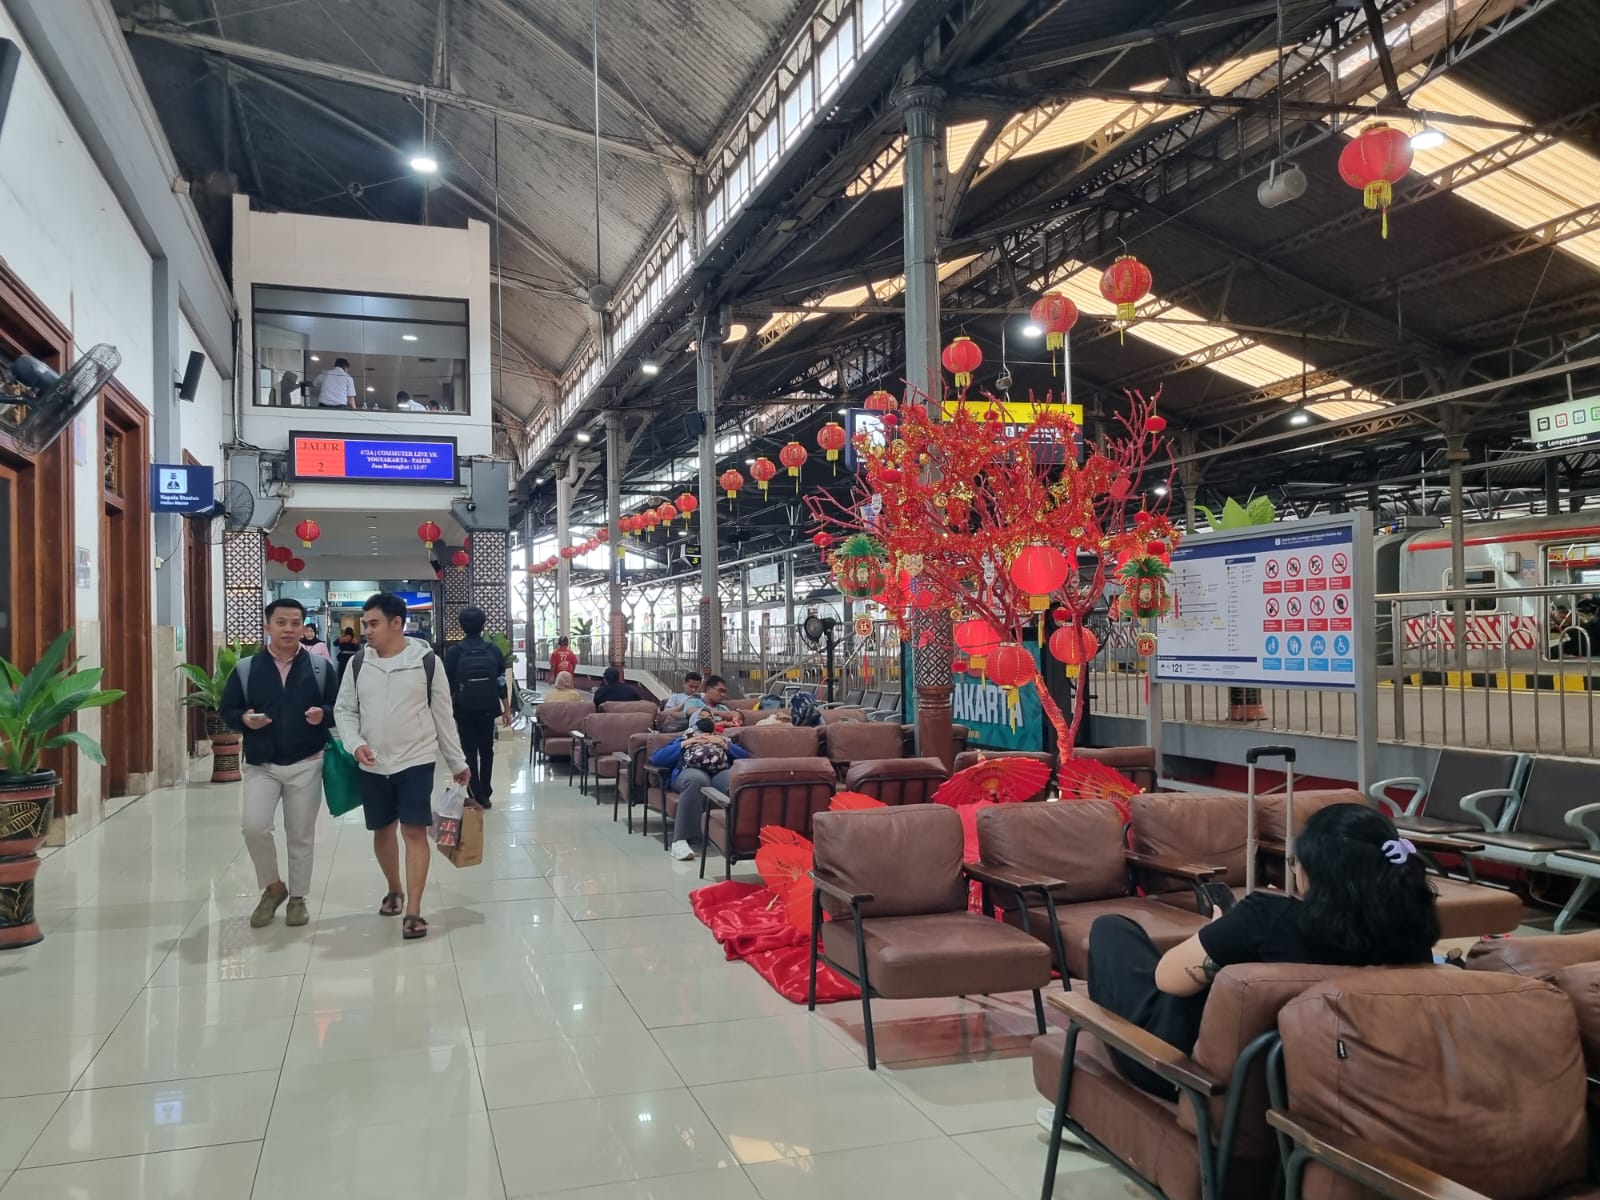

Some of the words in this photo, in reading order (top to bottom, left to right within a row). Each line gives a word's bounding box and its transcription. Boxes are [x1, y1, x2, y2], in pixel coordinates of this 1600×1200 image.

[301, 442, 339, 451] JALUR
[318, 462, 324, 472] 2
[1171, 663, 1183, 673] 121
[949, 683, 1023, 727] AKARTA
